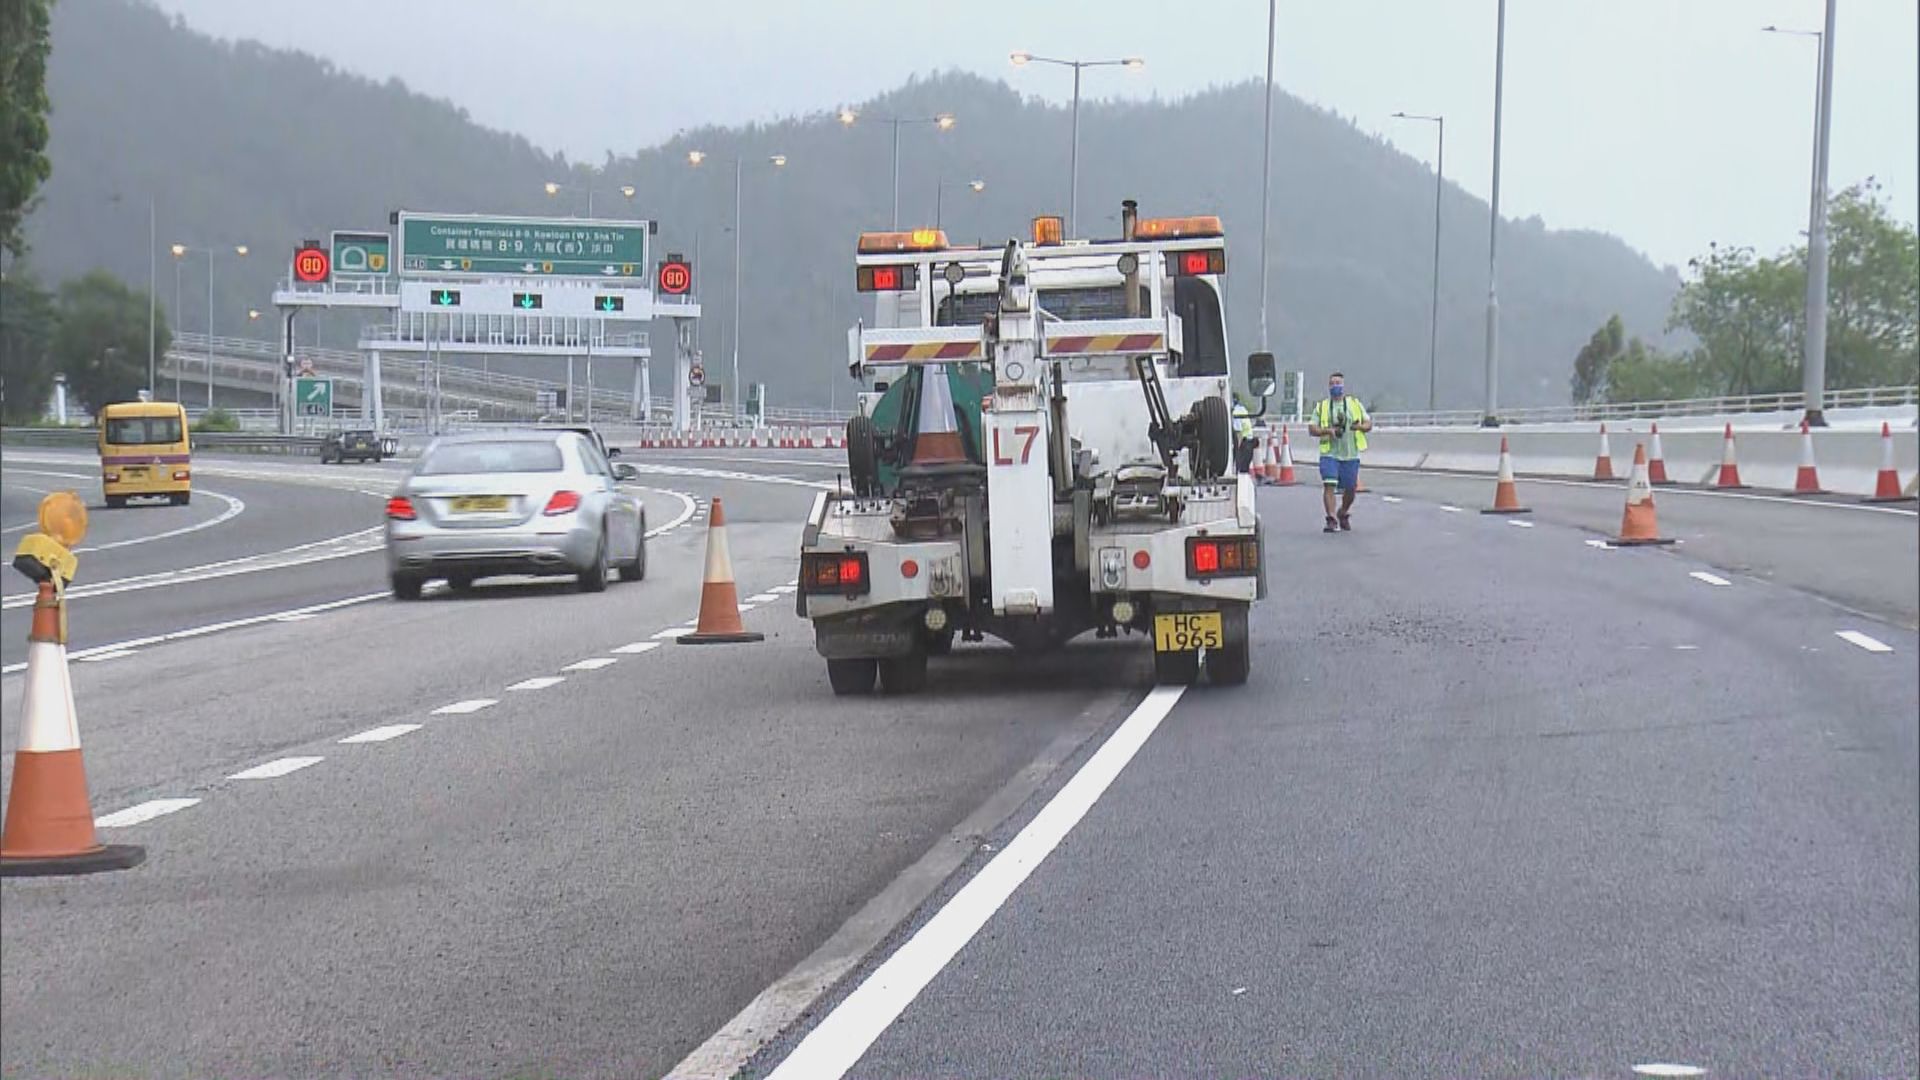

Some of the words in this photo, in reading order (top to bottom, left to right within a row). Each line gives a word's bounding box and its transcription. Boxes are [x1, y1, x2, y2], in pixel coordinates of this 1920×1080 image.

[430, 225, 472, 237] Container
[474, 228, 513, 238] Terminals
[534, 230, 570, 240] Kowloon
[593, 231, 610, 241] Sha
[612, 231, 624, 241] Tin
[302, 257, 322, 274] 80
[666, 271, 684, 286] 80
[993, 425, 1040, 466] L7
[1174, 615, 1202, 633] HC
[1165, 630, 1217, 651] 1965
